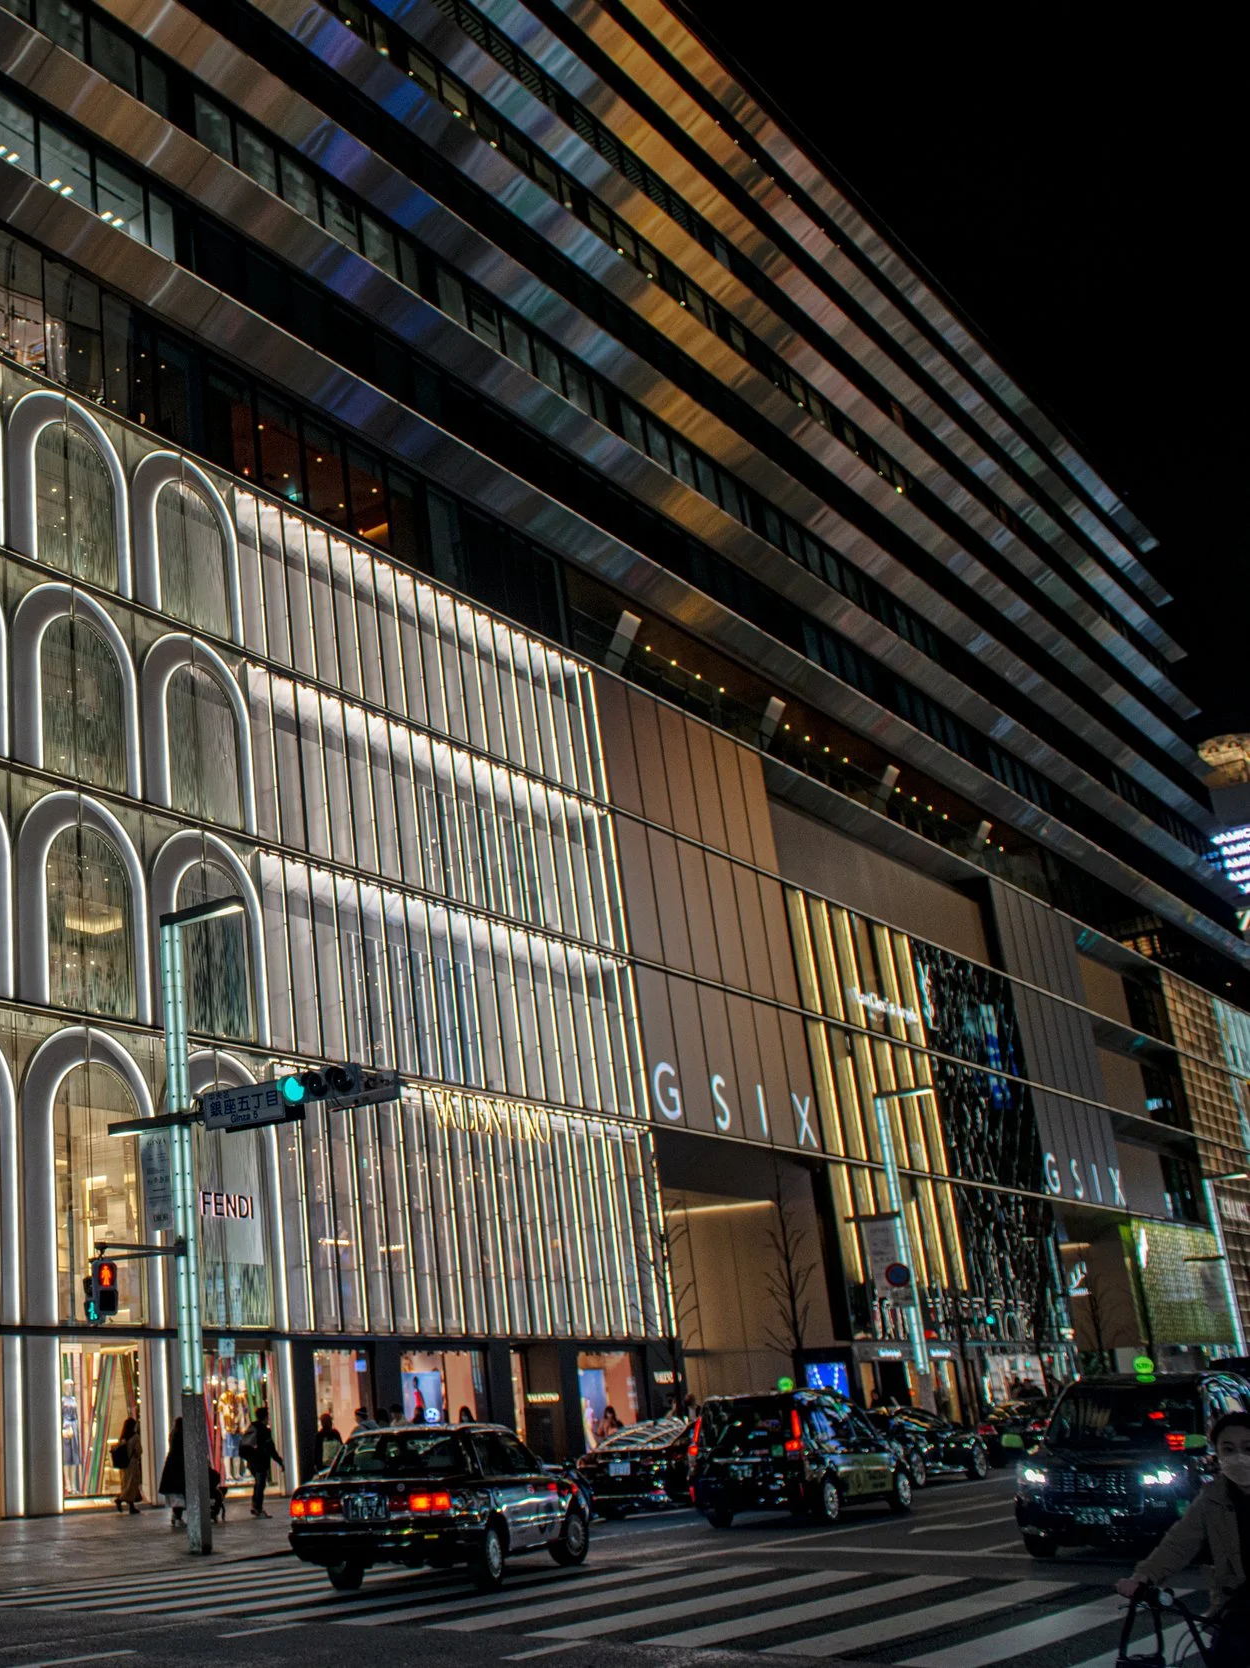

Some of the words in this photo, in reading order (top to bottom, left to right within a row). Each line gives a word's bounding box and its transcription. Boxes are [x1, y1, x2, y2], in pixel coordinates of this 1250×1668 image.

[210, 1090, 278, 1117] 銀座五丁目
[429, 1088, 551, 1144] VALENTINO
[230, 1113, 251, 1124] Ginza
[200, 1190, 254, 1220] FENDI
